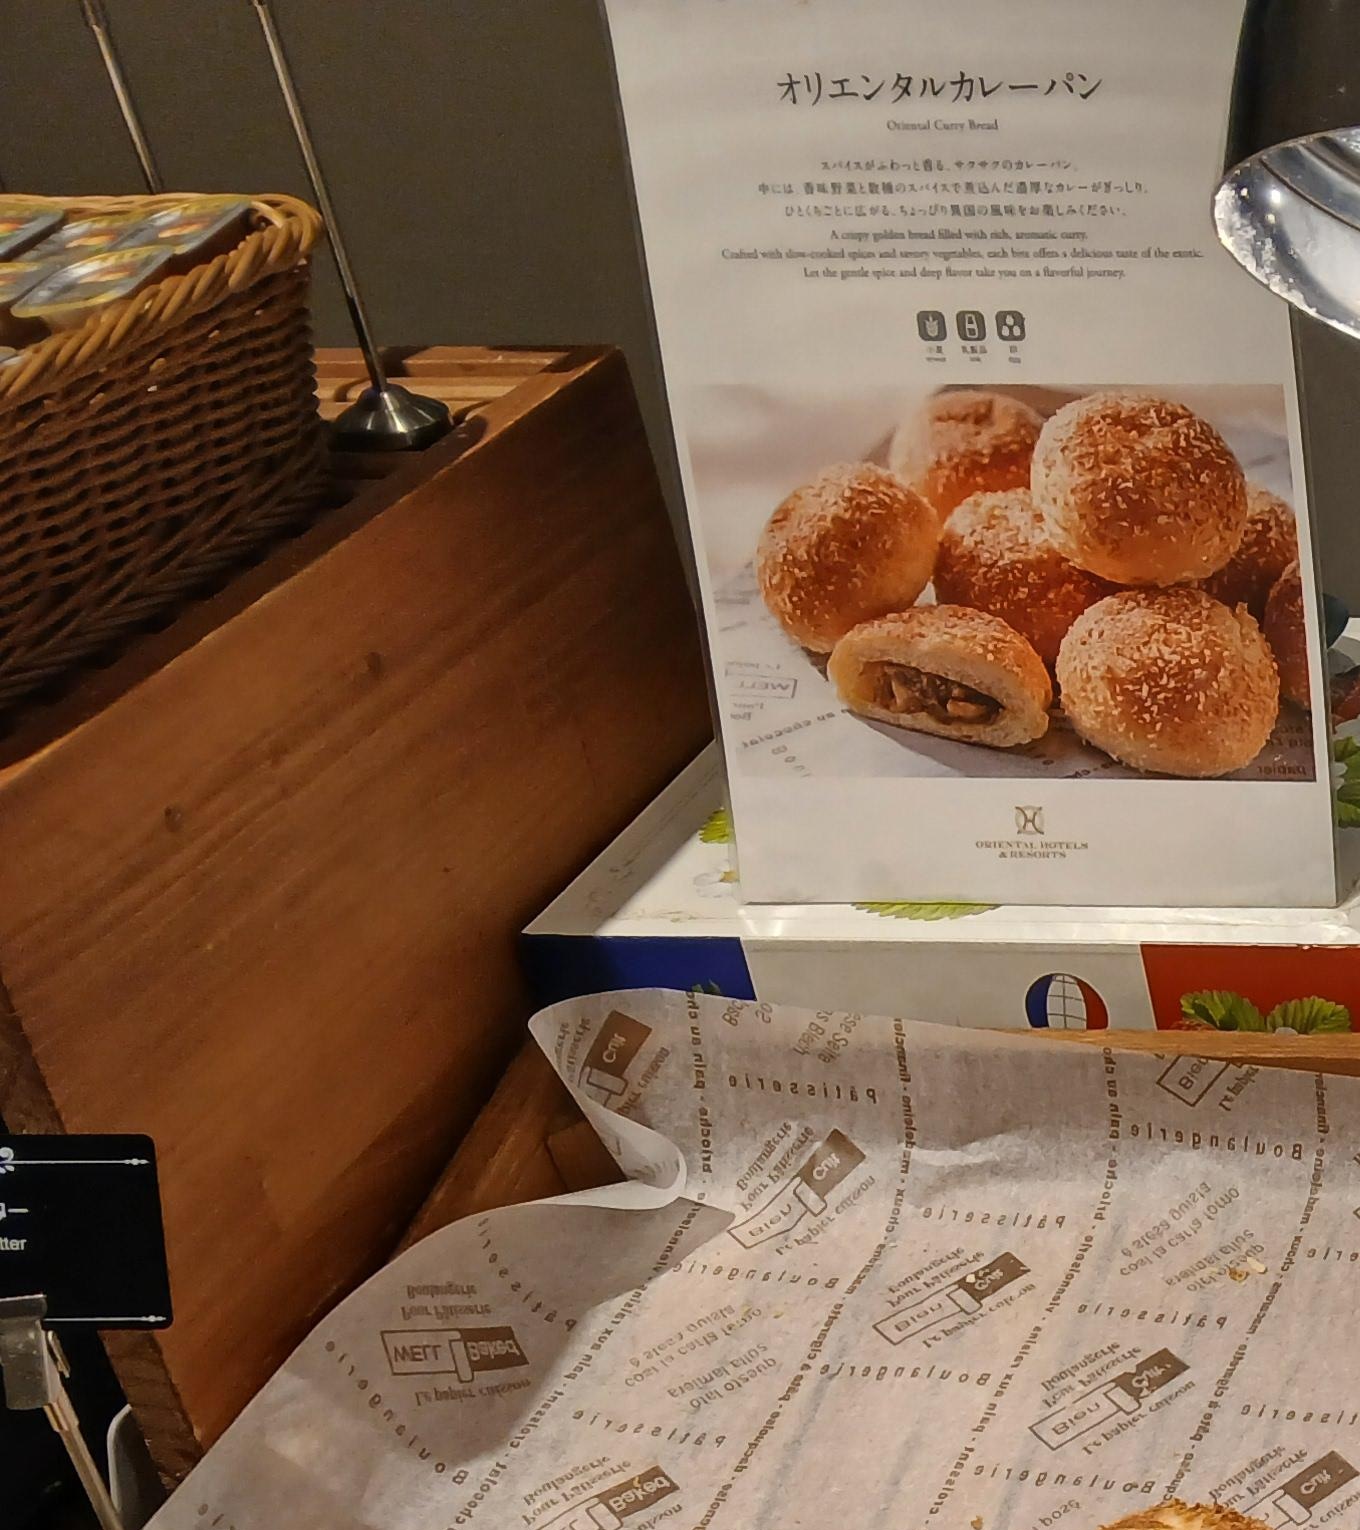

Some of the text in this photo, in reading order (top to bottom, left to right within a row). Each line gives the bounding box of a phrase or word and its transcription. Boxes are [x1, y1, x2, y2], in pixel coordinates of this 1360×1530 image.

[776, 70, 1103, 107] オリエンタルカレーパン
[934, 119, 965, 131] Curry
[967, 118, 999, 130] Bread
[830, 229, 839, 240] A
[908, 229, 935, 240] bread
[938, 229, 962, 240] filled
[964, 229, 988, 240] with
[760, 248, 783, 259] with
[1070, 248, 1113, 259] delicious
[1141, 248, 1152, 259] of
[1154, 248, 1169, 259] the
[823, 267, 838, 278] the
[900, 267, 917, 278] and
[976, 267, 995, 278] take
[998, 267, 1017, 280] you
[1019, 267, 1032, 278] on
[975, 840, 1088, 850] ORIENTAL HOTELS
[1010, 851, 1066, 859] RESORTS
